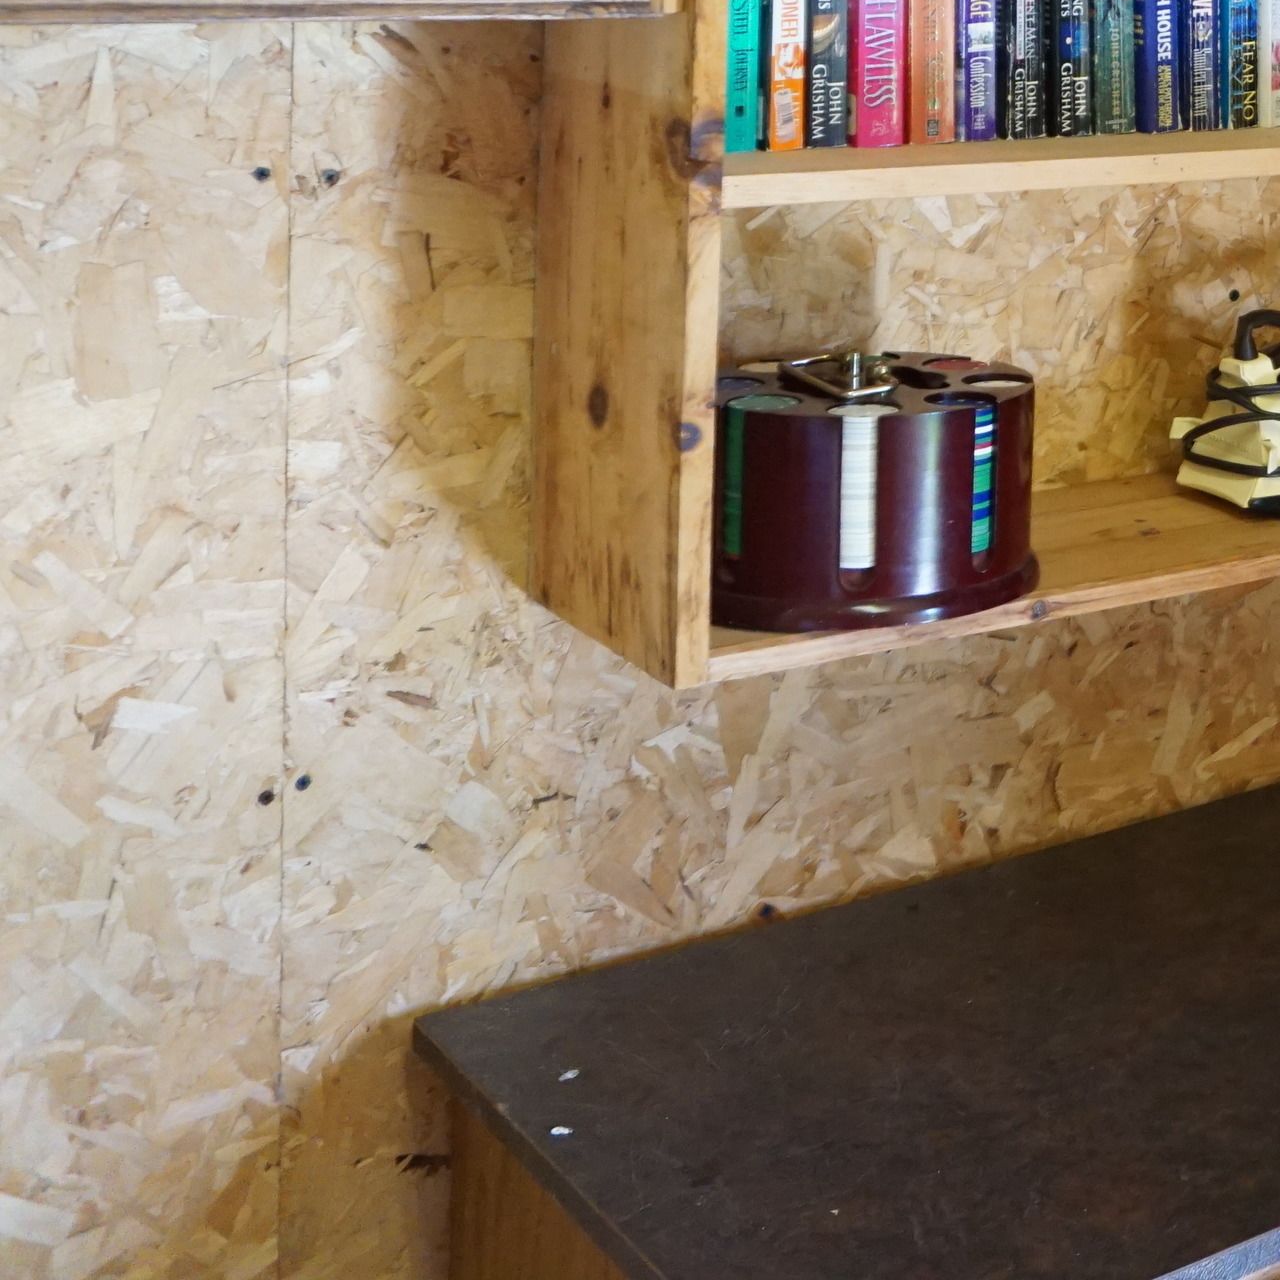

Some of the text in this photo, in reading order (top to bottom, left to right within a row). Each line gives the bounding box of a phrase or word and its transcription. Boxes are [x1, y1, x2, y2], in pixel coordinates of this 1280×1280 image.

[1026, 27, 1037, 59] MAN
[1156, 9, 1172, 62] HOUSE
[811, 64, 846, 140] JOHN GRISHAM
[970, 56, 993, 109] Confession
[1014, 69, 1039, 133] JOHN GRISHAM
[1060, 63, 1088, 133] JOHN GRISHAM
